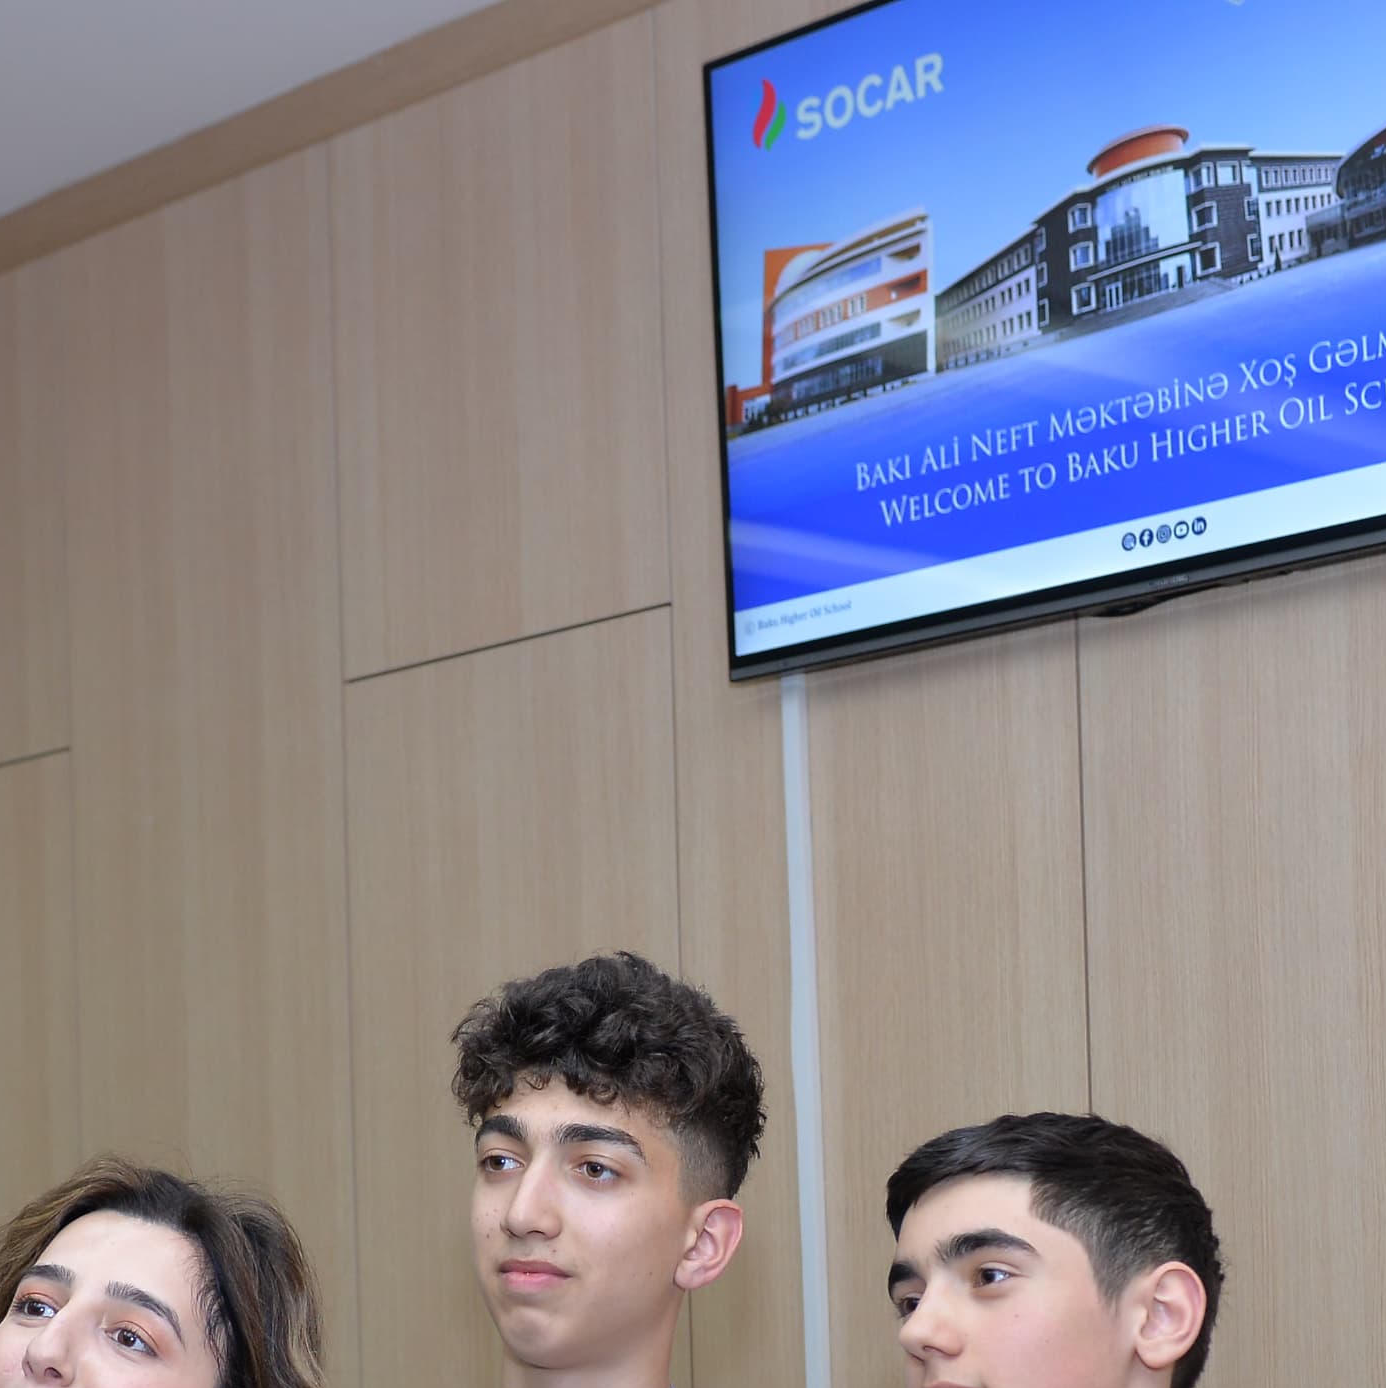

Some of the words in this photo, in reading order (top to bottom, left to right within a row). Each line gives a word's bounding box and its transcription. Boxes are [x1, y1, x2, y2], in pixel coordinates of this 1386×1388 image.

[796, 52, 944, 140] SOCAR
[880, 473, 1010, 527] WELCOME
[1018, 463, 1056, 493] TO
[1067, 441, 1139, 483] BAKU
[1151, 410, 1269, 462] HIGHER
[1279, 394, 1333, 430] OIL
[920, 436, 960, 475] ALİ
[971, 420, 1038, 462] NEFT
[1048, 372, 1229, 441] MƏKTƏBİNƏ
[1239, 353, 1296, 393] XOŞ
